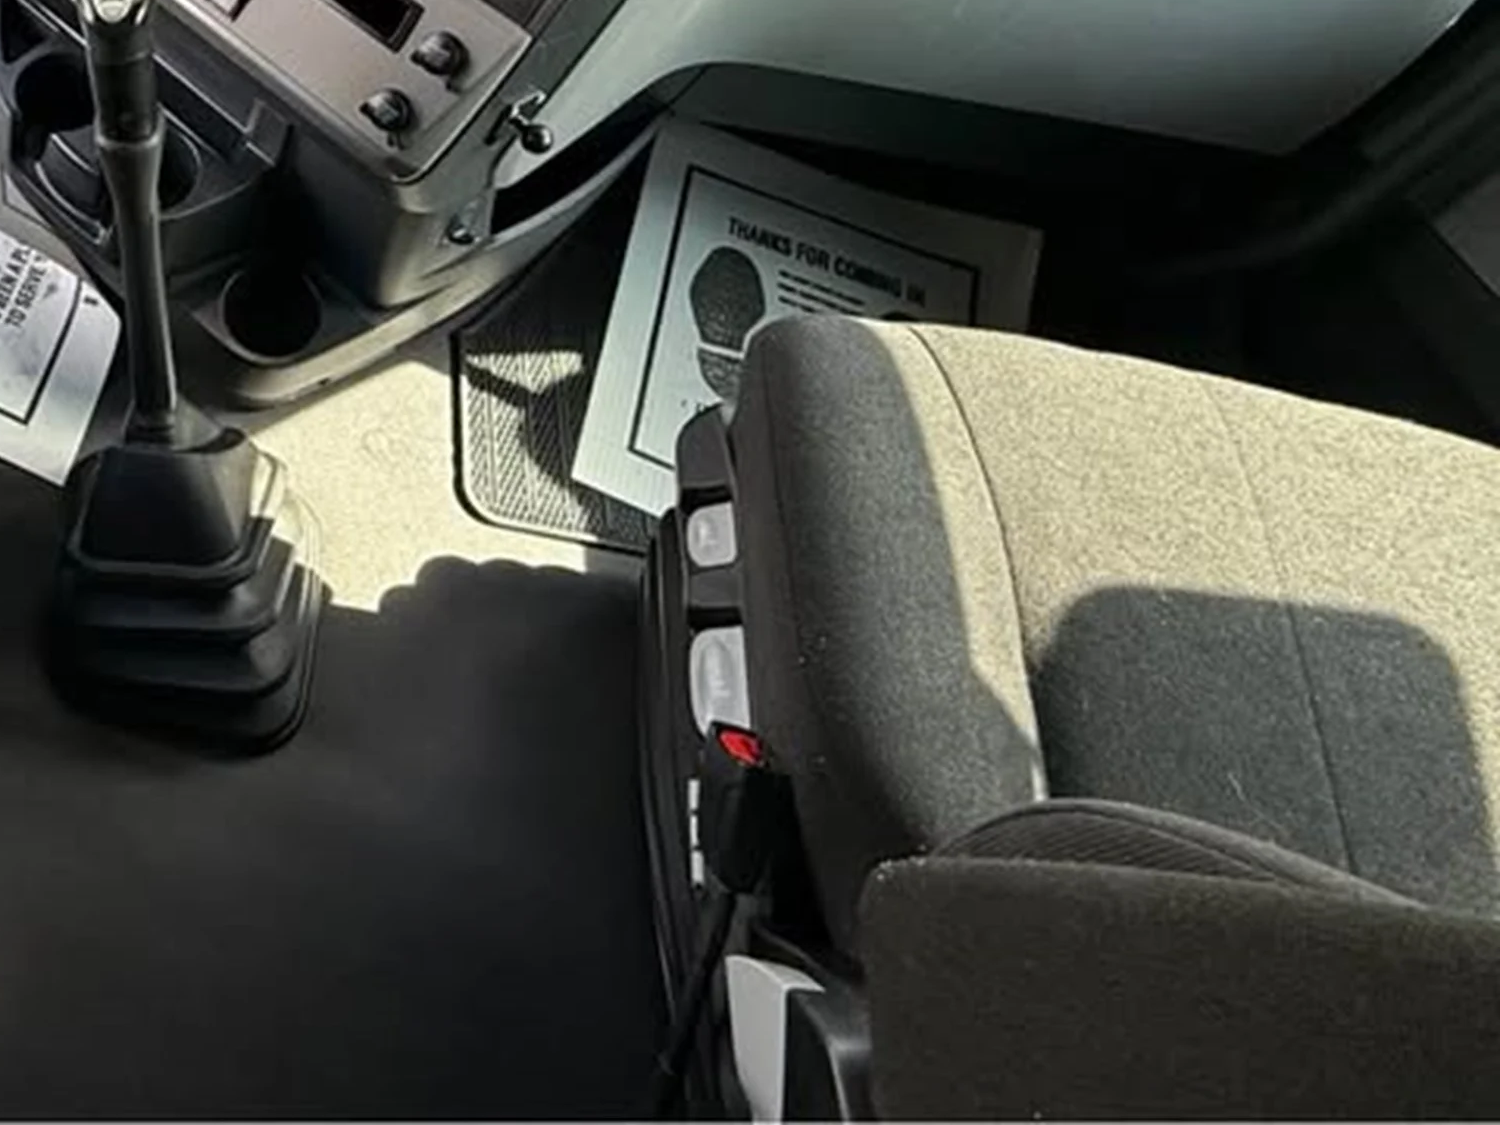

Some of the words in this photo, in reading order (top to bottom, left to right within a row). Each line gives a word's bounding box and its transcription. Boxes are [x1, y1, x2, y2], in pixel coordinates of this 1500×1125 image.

[729, 217, 791, 257] THANKS
[796, 241, 830, 271] FOR
[14, 265, 47, 309] SERVE
[4, 307, 27, 329] TO
